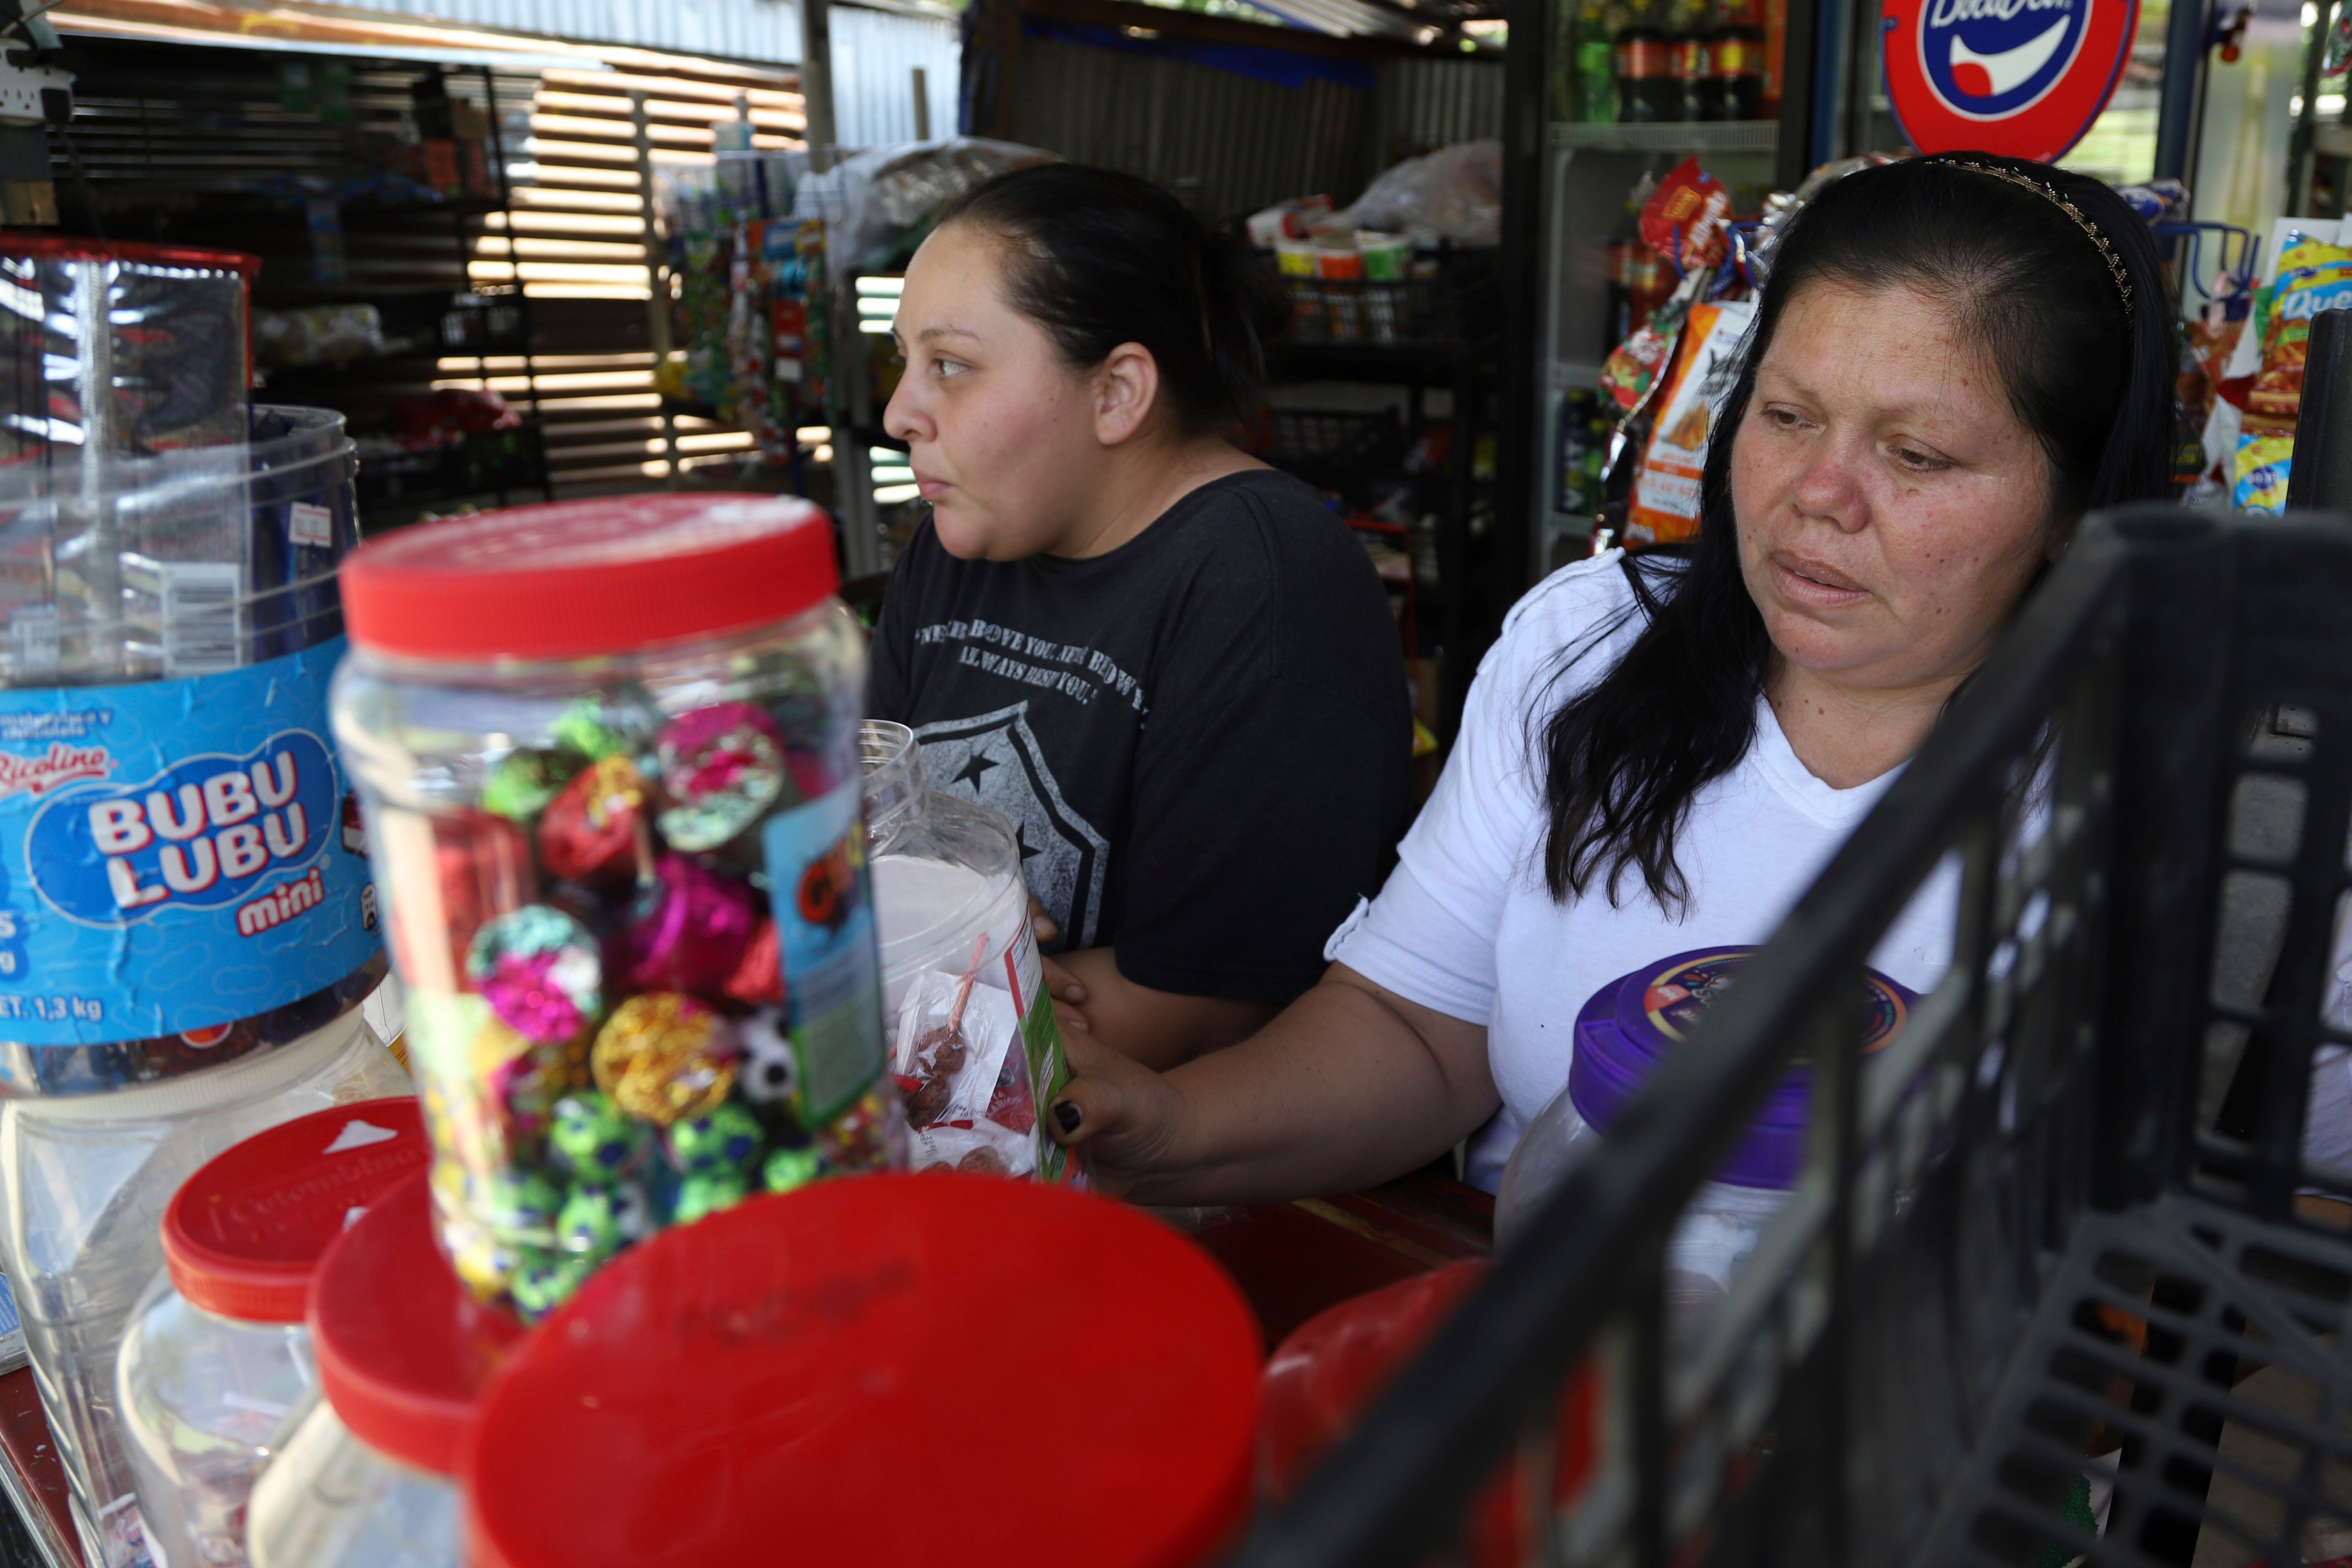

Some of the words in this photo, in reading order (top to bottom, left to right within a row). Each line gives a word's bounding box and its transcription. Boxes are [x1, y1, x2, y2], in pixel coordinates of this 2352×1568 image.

[89, 750, 298, 855] BUBU
[107, 802, 308, 908] LUBU
[236, 866, 324, 937] mini
[72, 995, 102, 1022] kg
